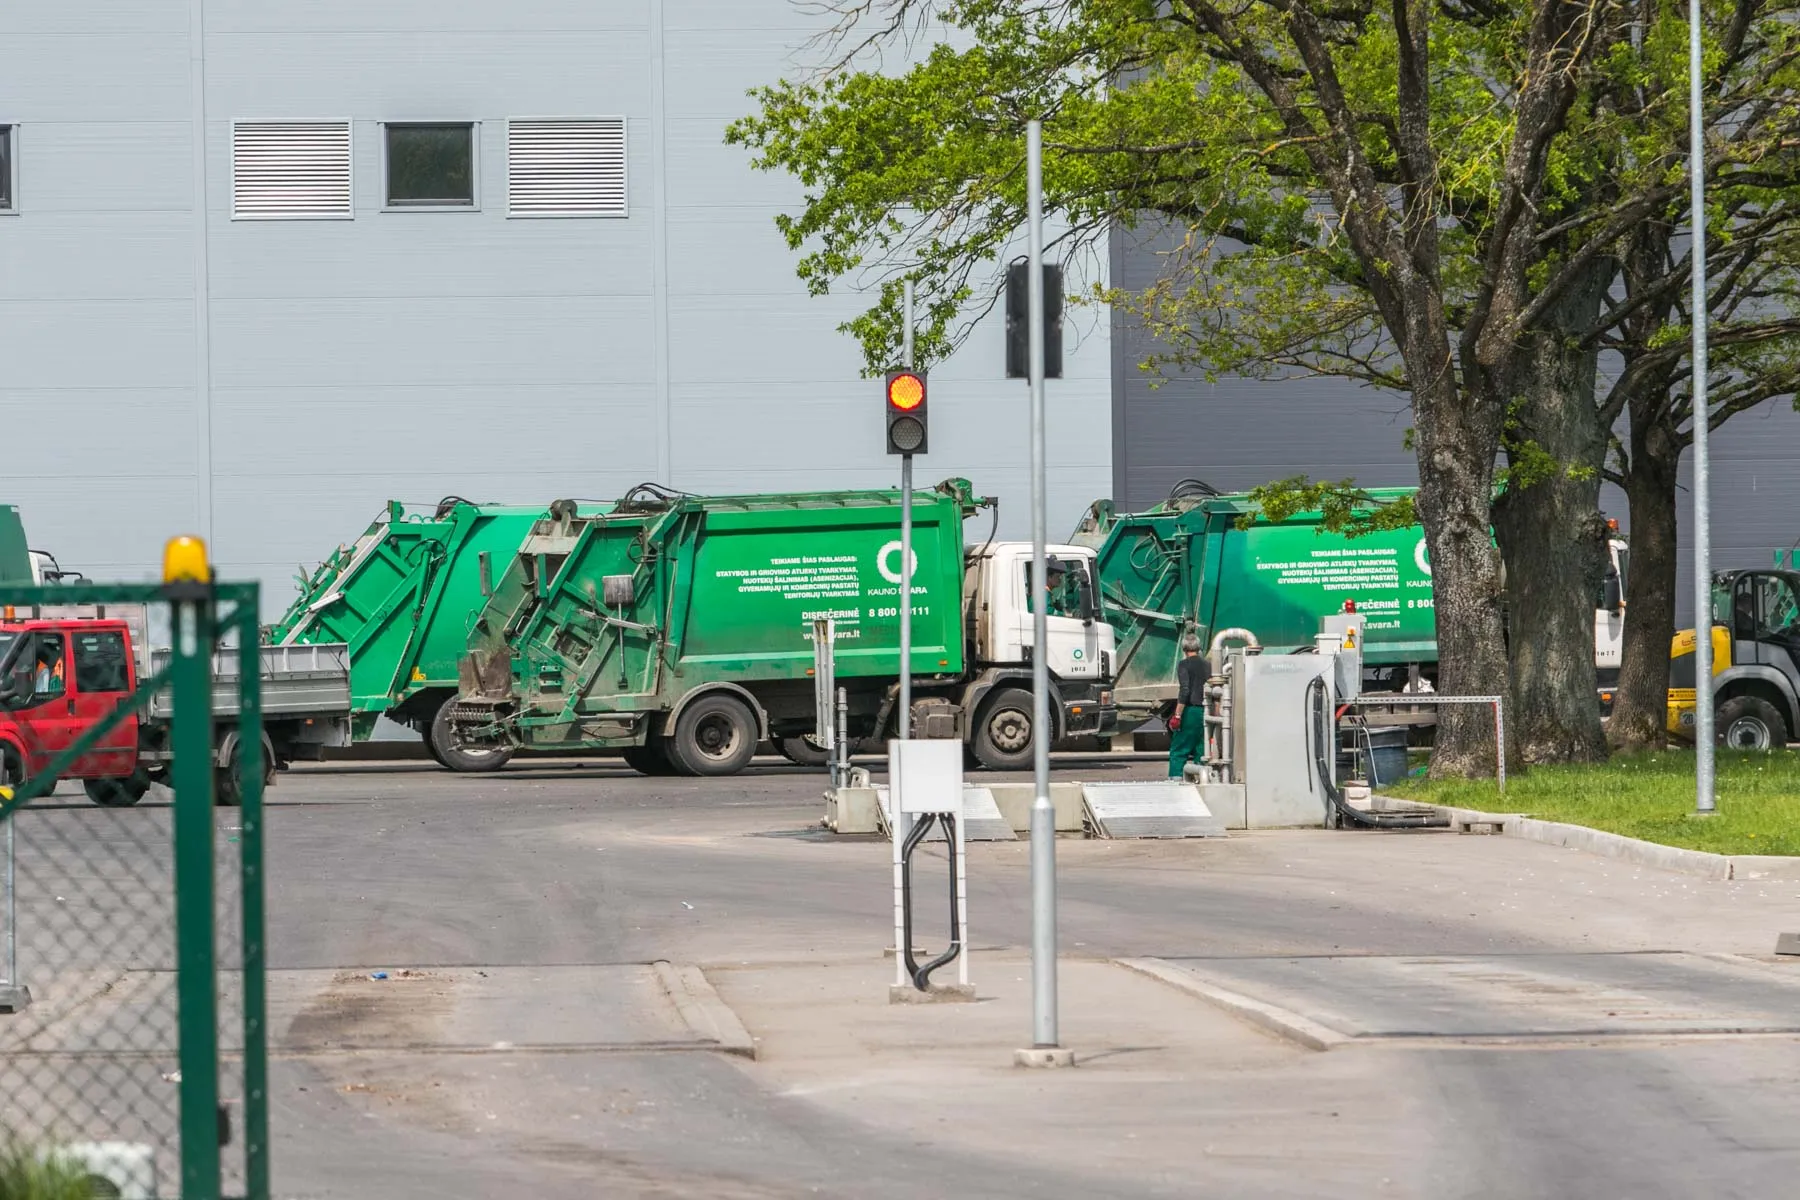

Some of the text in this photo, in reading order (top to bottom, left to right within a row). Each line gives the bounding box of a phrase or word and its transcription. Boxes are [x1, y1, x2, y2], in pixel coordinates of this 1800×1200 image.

[868, 586, 928, 596] KAUNO ŠARA
[1408, 600, 1414, 608] 8
[802, 607, 929, 620] DISPEČERINĖ 8 800 111
